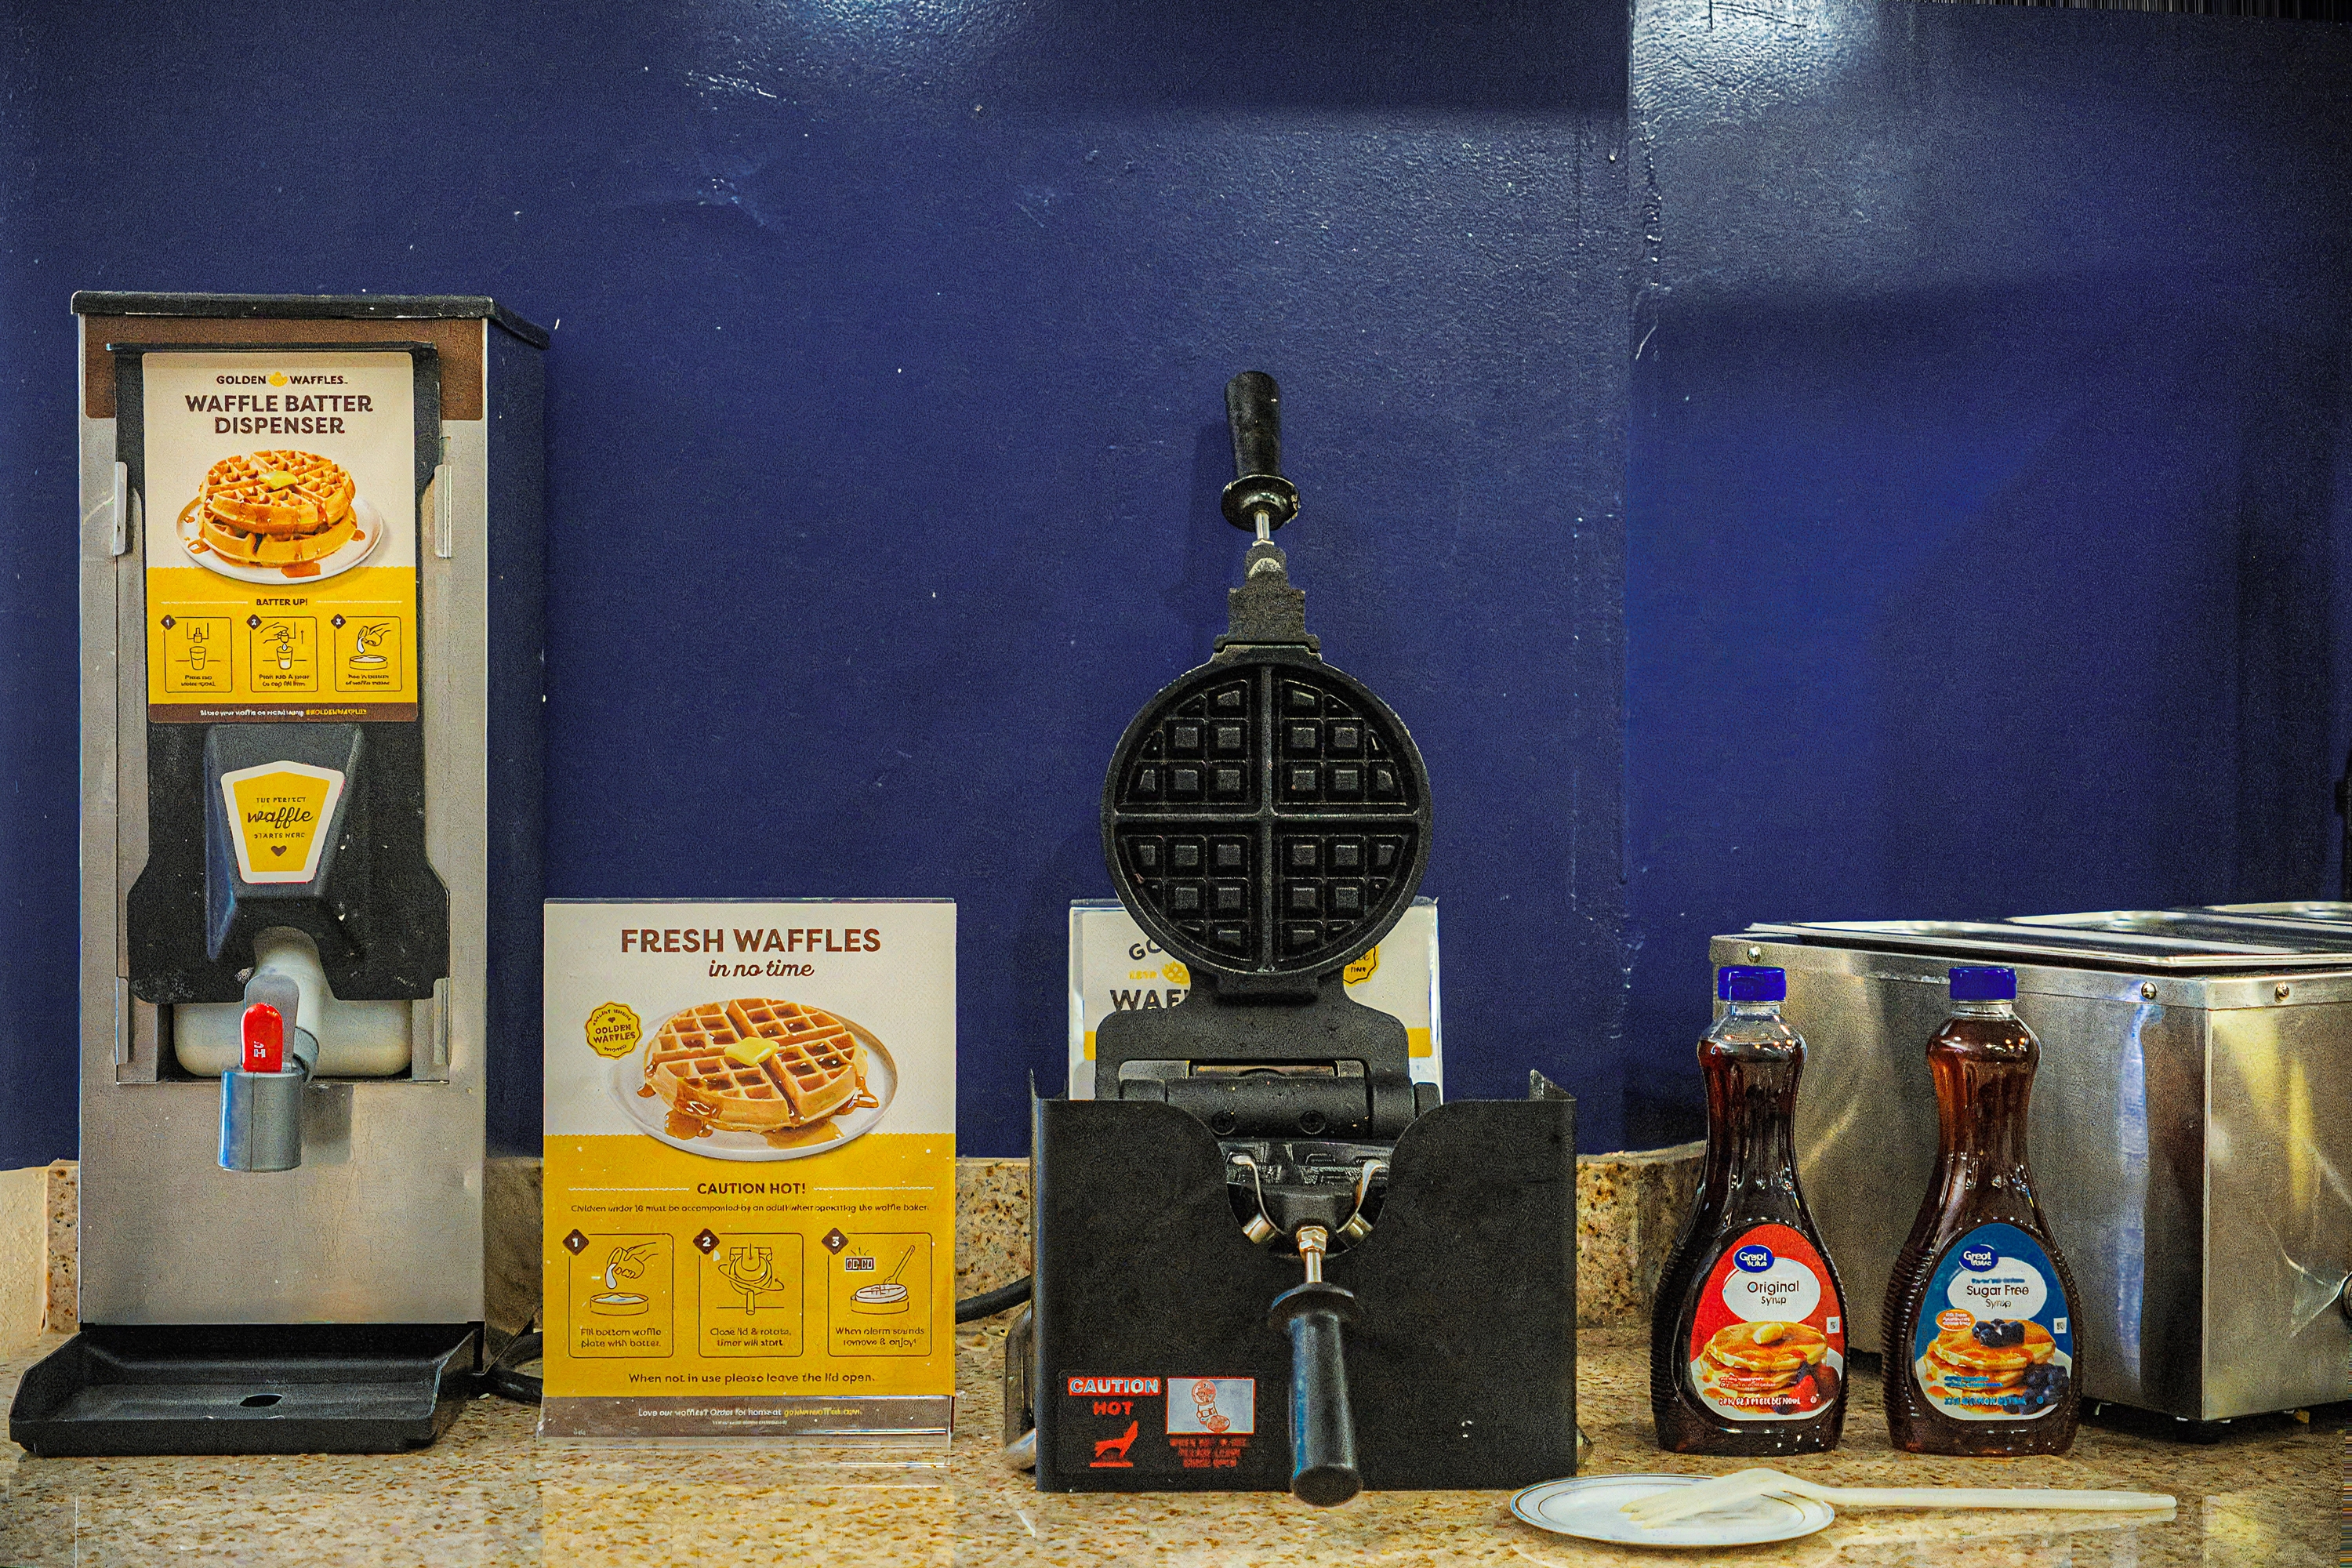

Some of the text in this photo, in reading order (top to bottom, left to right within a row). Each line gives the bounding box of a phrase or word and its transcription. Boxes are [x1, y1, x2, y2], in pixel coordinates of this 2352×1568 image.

[216, 375, 345, 385] GOLDEN WAFFLES
[185, 394, 373, 413] WAFFLE BATTER
[214, 416, 346, 434] DISPENSER
[248, 807, 314, 829] waffle
[621, 928, 881, 953] FRESH WAFFLES
[708, 959, 815, 978] in no time
[1109, 989, 1189, 1011] WAF
[697, 1182, 806, 1195] CAUTION HOT!
[572, 1238, 579, 1247] 1
[702, 1236, 711, 1247] 2
[831, 1236, 840, 1247] 3
[1963, 1250, 1991, 1261] Great
[1747, 1280, 1799, 1296] Original
[1966, 1285, 2029, 1298] Sugar Free
[1761, 1296, 1787, 1306] Syrup
[1985, 1298, 2012, 1309] Syrup
[581, 1339, 605, 1348] plate
[629, 1374, 662, 1382] When
[688, 1374, 698, 1382] in
[724, 1374, 764, 1385] please
[767, 1373, 798, 1382] leave
[802, 1373, 822, 1382] the
[825, 1373, 839, 1382] lid
[842, 1374, 876, 1385] open.
[1070, 1379, 1159, 1393] CAUTION
[1092, 1401, 1134, 1416] HOT
